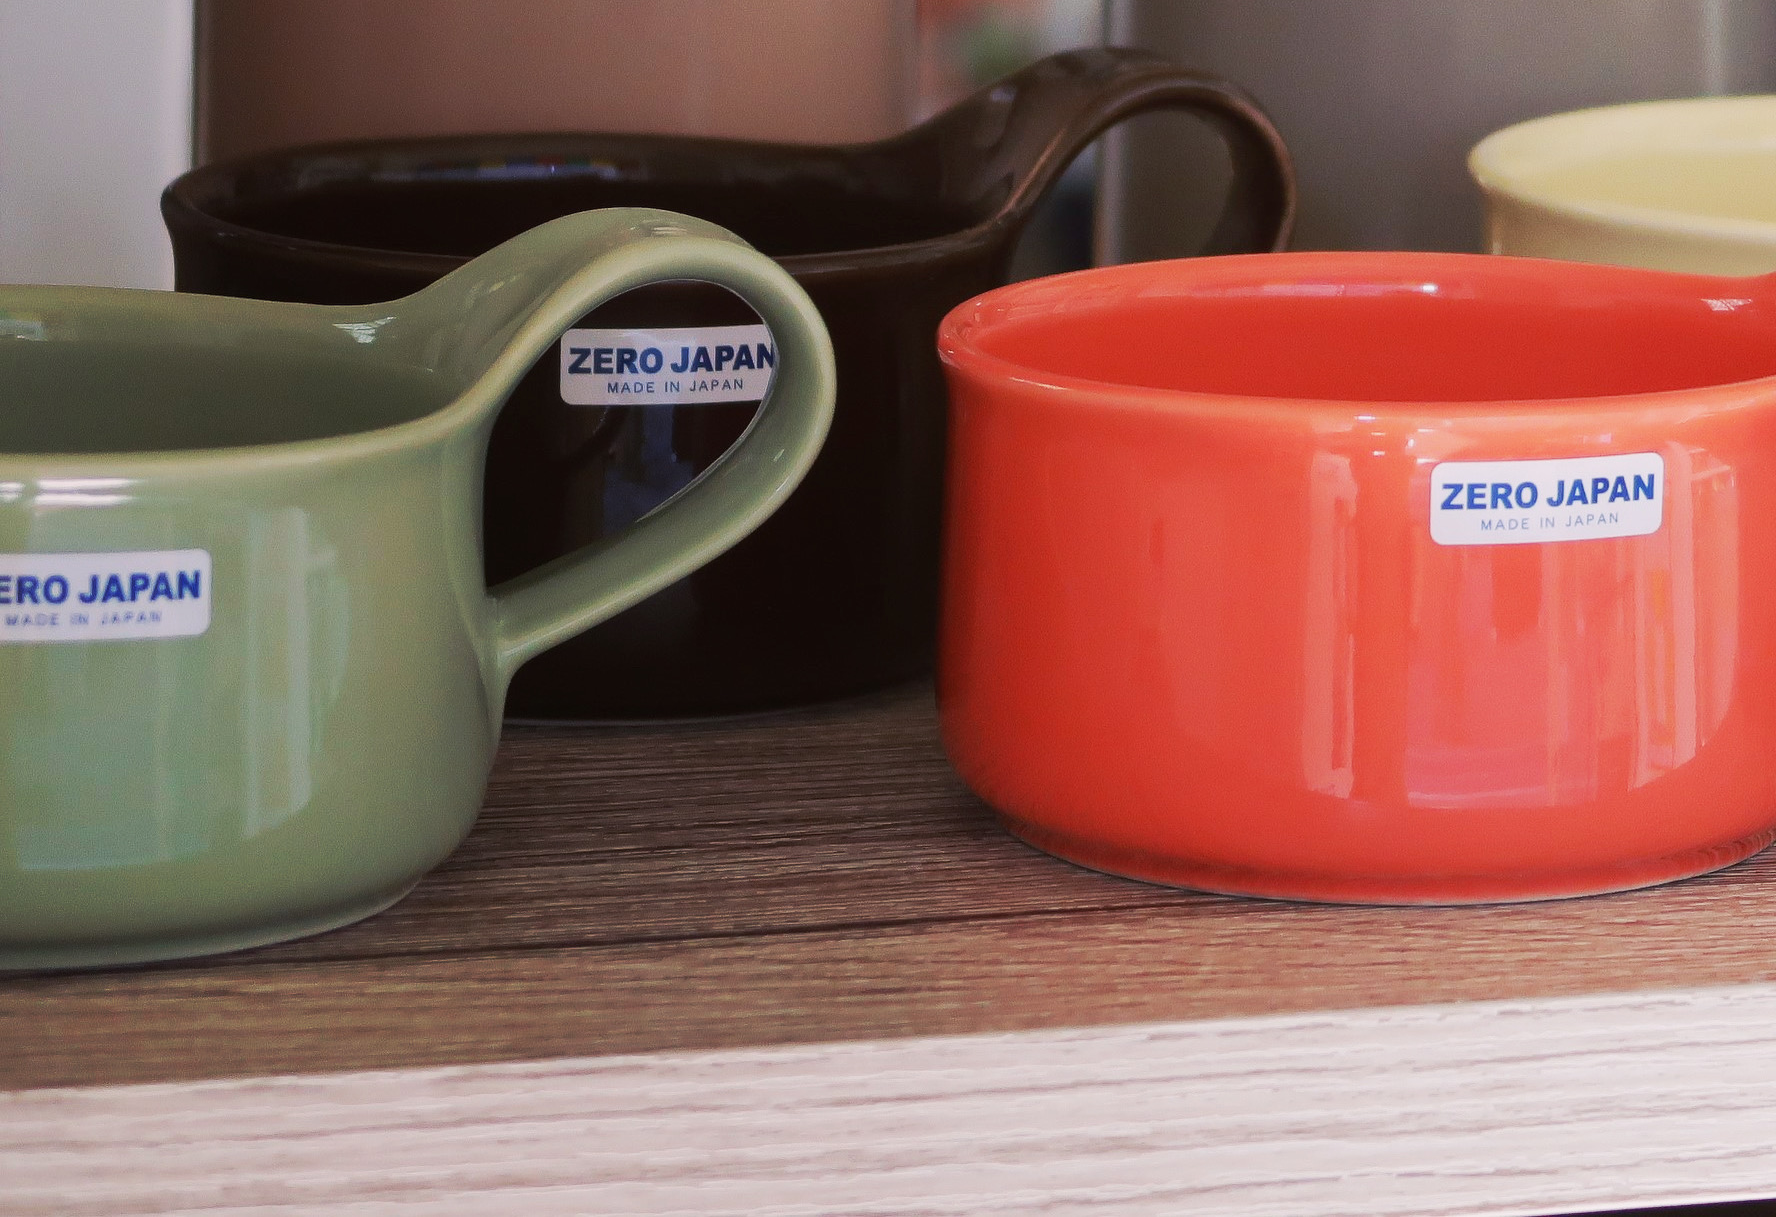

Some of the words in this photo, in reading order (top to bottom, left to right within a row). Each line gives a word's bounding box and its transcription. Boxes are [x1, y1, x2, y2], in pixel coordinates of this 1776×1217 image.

[567, 347, 664, 375] ZERO
[607, 381, 655, 393] MADE
[664, 381, 680, 392] IN
[689, 378, 744, 392] JAPAN
[1440, 482, 1538, 510] ZERO
[1546, 473, 1655, 507] JAPAN
[1480, 517, 1530, 531] MADE
[1540, 517, 1555, 528] IN
[1565, 512, 1619, 527] JAPAN
[0, 574, 69, 604] ERO
[79, 569, 201, 603] JAPAN
